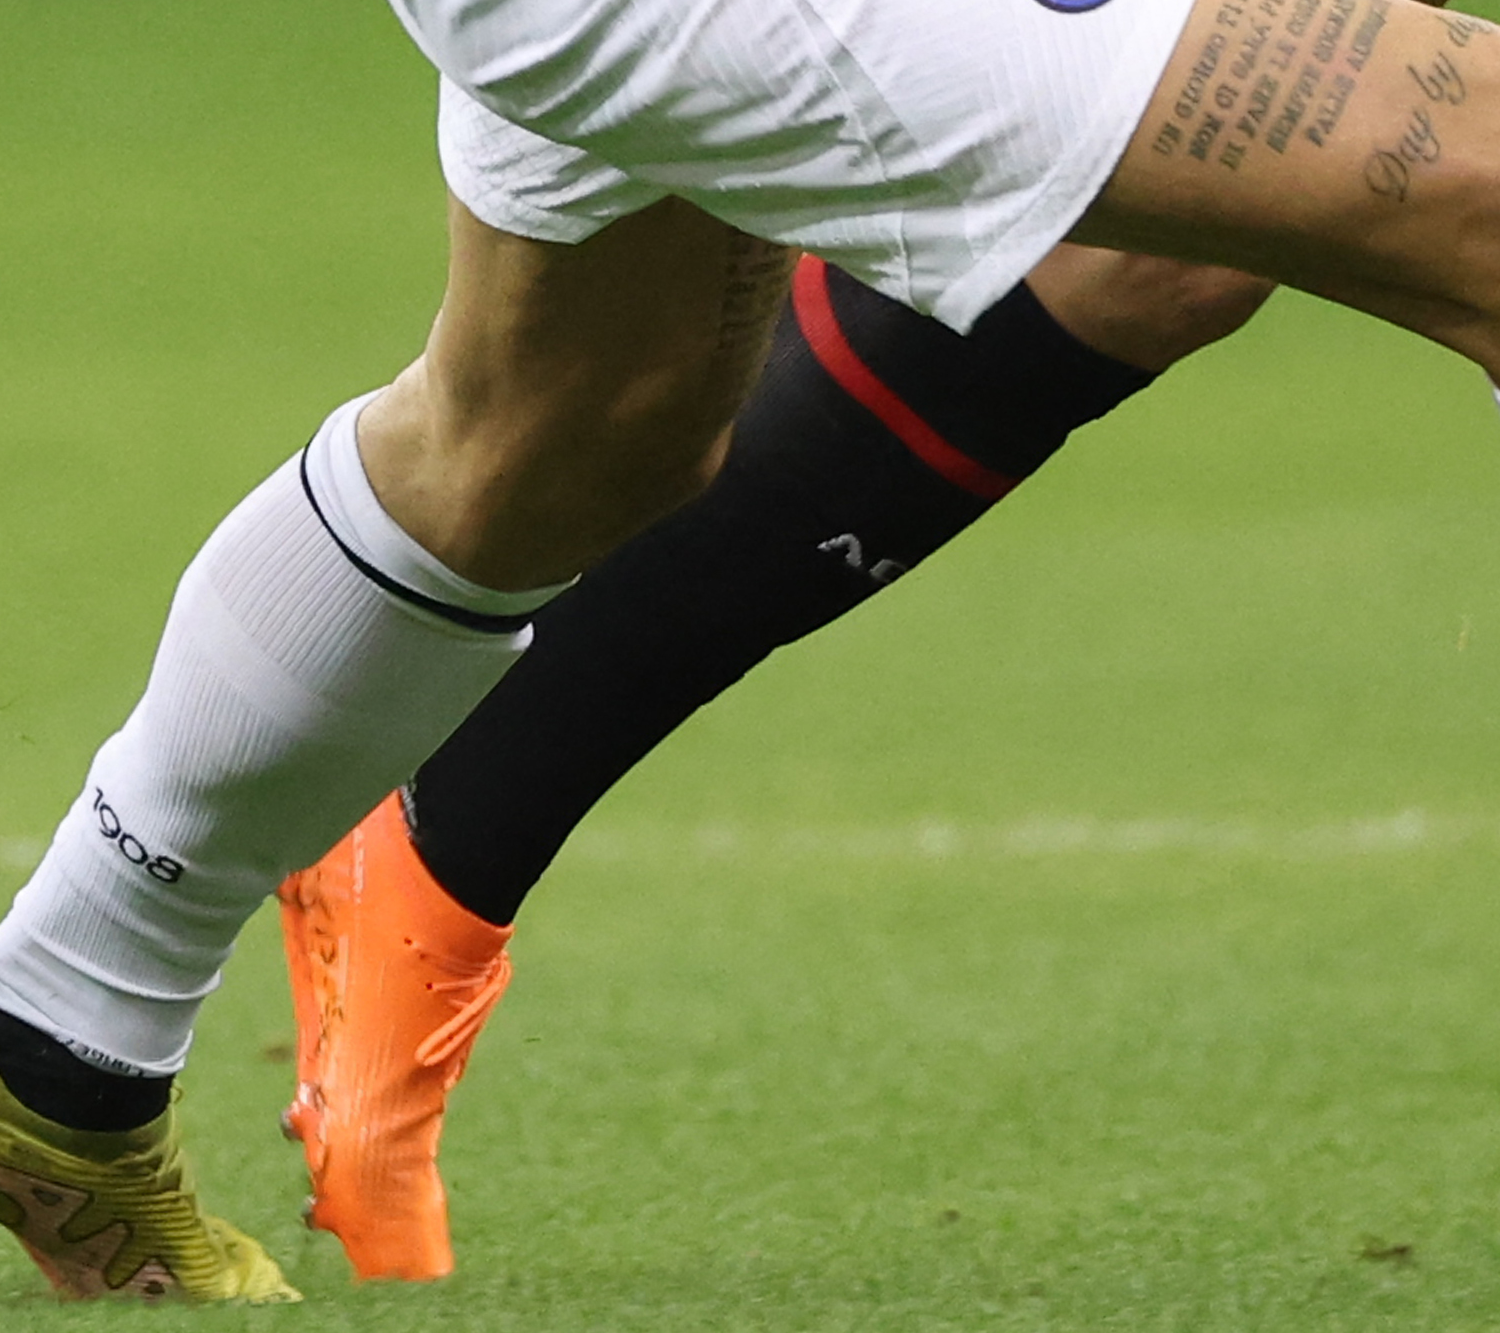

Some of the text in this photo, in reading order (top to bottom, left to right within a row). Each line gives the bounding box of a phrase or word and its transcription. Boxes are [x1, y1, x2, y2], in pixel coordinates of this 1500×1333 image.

[1365, 107, 1440, 202] Day
[1406, 51, 1467, 106] by
[93, 786, 185, 883] 1908
